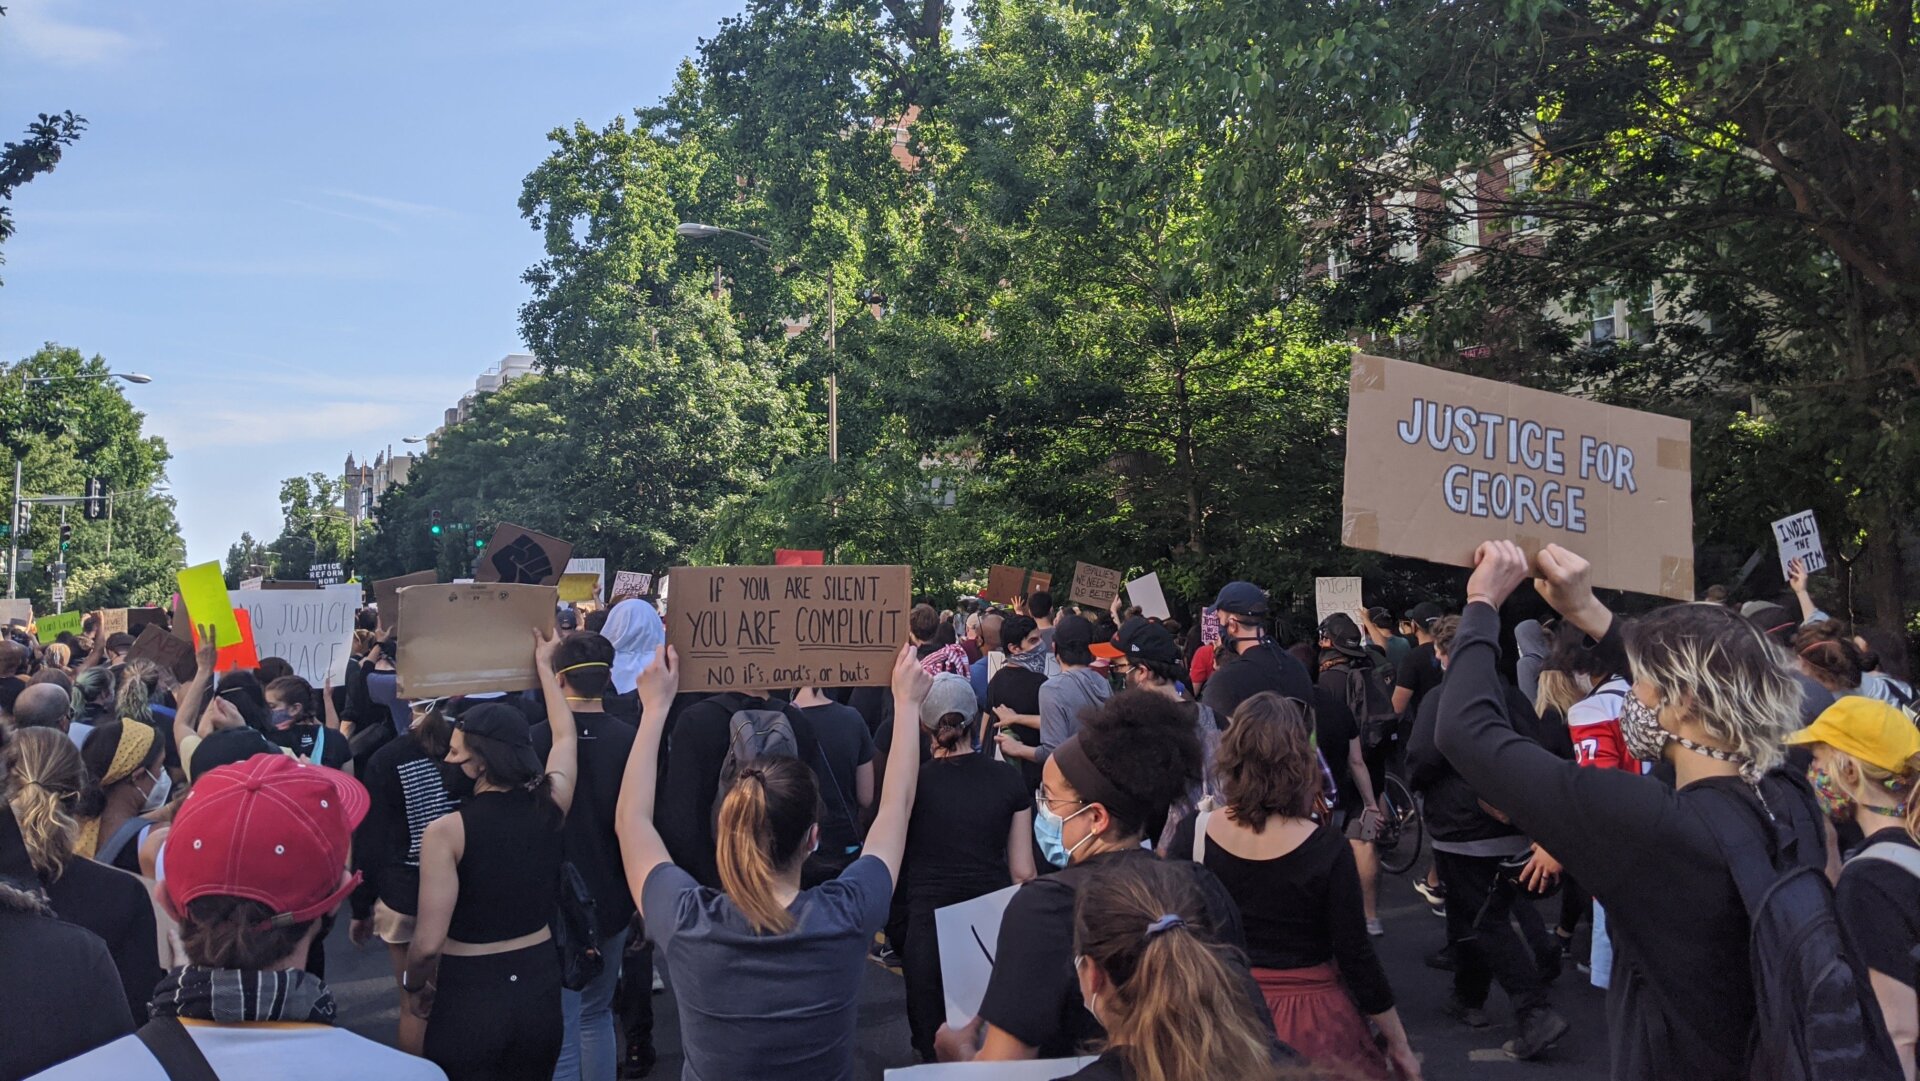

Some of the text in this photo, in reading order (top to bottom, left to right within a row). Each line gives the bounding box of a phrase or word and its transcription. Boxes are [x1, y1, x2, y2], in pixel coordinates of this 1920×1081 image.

[1398, 398, 1637, 494] JUSTICE FOR
[1443, 464, 1586, 533] GEORGE
[1777, 514, 1815, 543] INDICT
[1794, 538, 1810, 551] THE
[309, 563, 341, 571] JUSTICE
[309, 569, 344, 579] REFORM
[1787, 550, 1826, 579] STEM
[318, 577, 338, 585] NOW!
[617, 572, 635, 583] REST
[640, 574, 651, 585] IN
[622, 582, 644, 591] POWER
[1087, 576, 1105, 588] NEED
[1108, 581, 1118, 590] TO
[1317, 578, 1361, 594] MIGHT
[709, 576, 888, 605] IF YOU ARE SILENT,
[277, 602, 350, 636] JUSTICE
[686, 606, 901, 648] YOU ARE COMPLICIT
[707, 666, 735, 685] NO
[820, 667, 830, 681] or
[840, 662, 870, 682] but's
